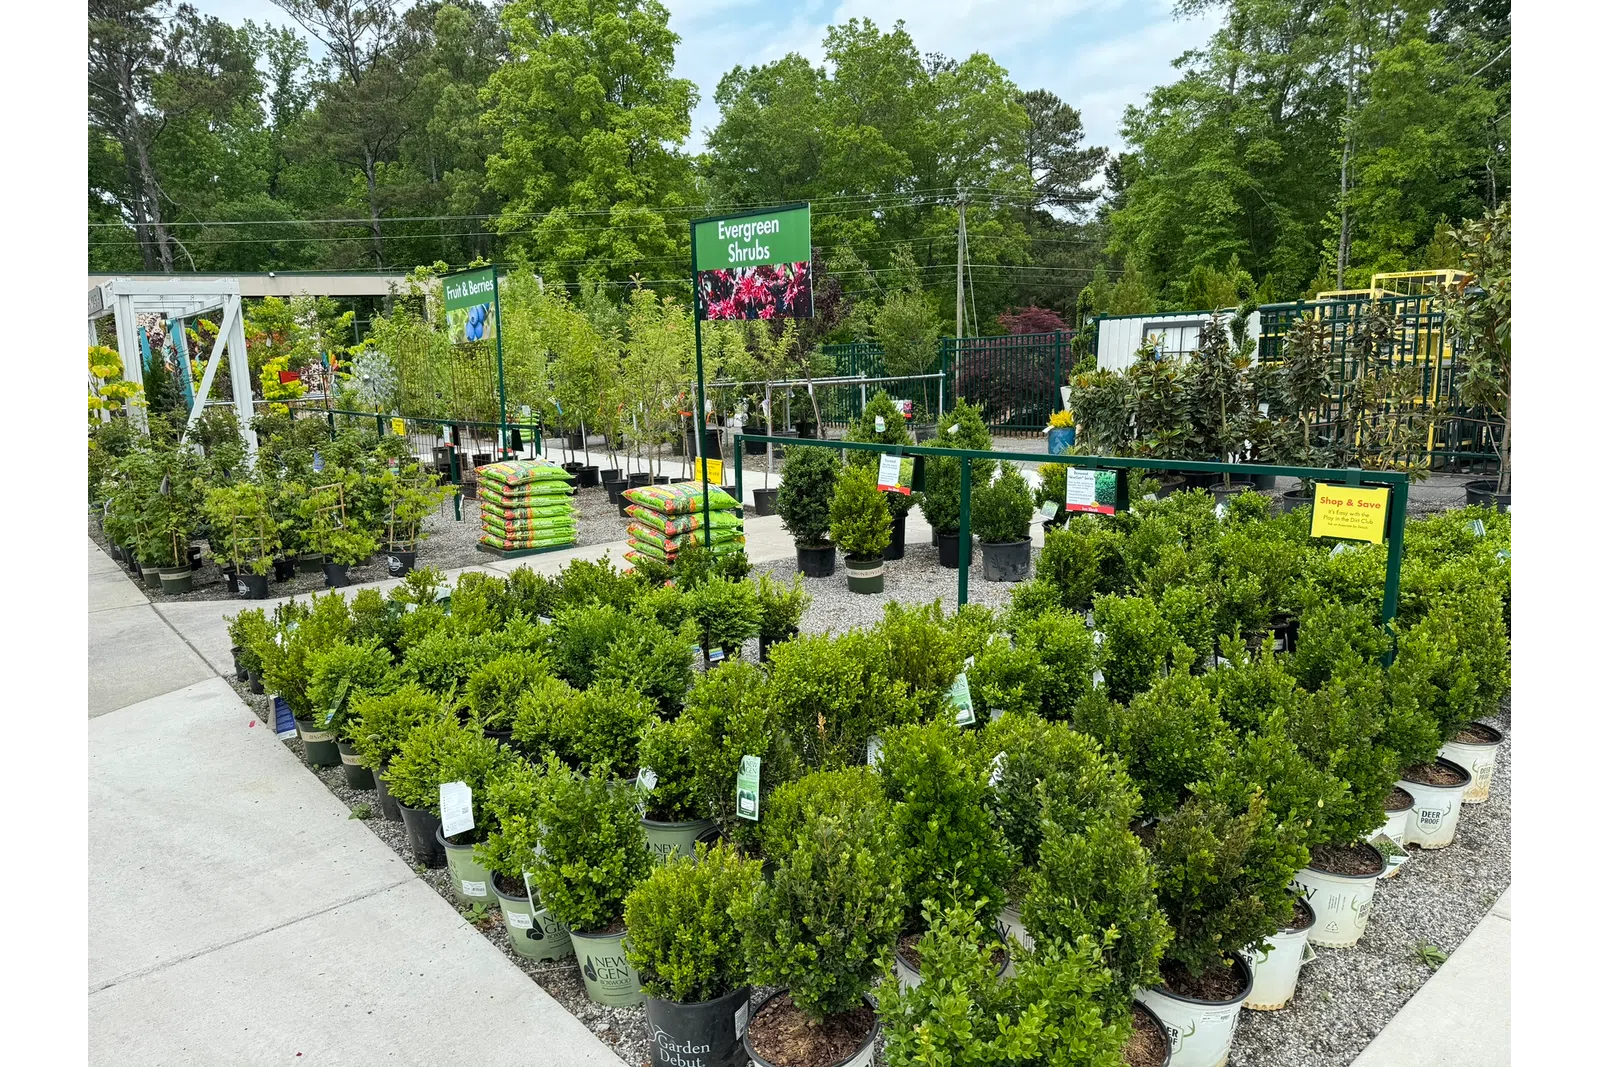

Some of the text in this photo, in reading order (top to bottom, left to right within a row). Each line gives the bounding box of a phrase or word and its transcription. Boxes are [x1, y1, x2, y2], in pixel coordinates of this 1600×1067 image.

[718, 219, 780, 242] Evergreen
[728, 239, 771, 263] Shrubs
[446, 276, 494, 300] Fruit & Berries
[1320, 496, 1343, 507] Shop
[1357, 500, 1381, 509] Save
[1421, 810, 1441, 819] DEER
[595, 956, 626, 968] NEW
[597, 966, 629, 980] GEN
[601, 978, 632, 986] BOXWOOD
[658, 1034, 711, 1054] Garden
